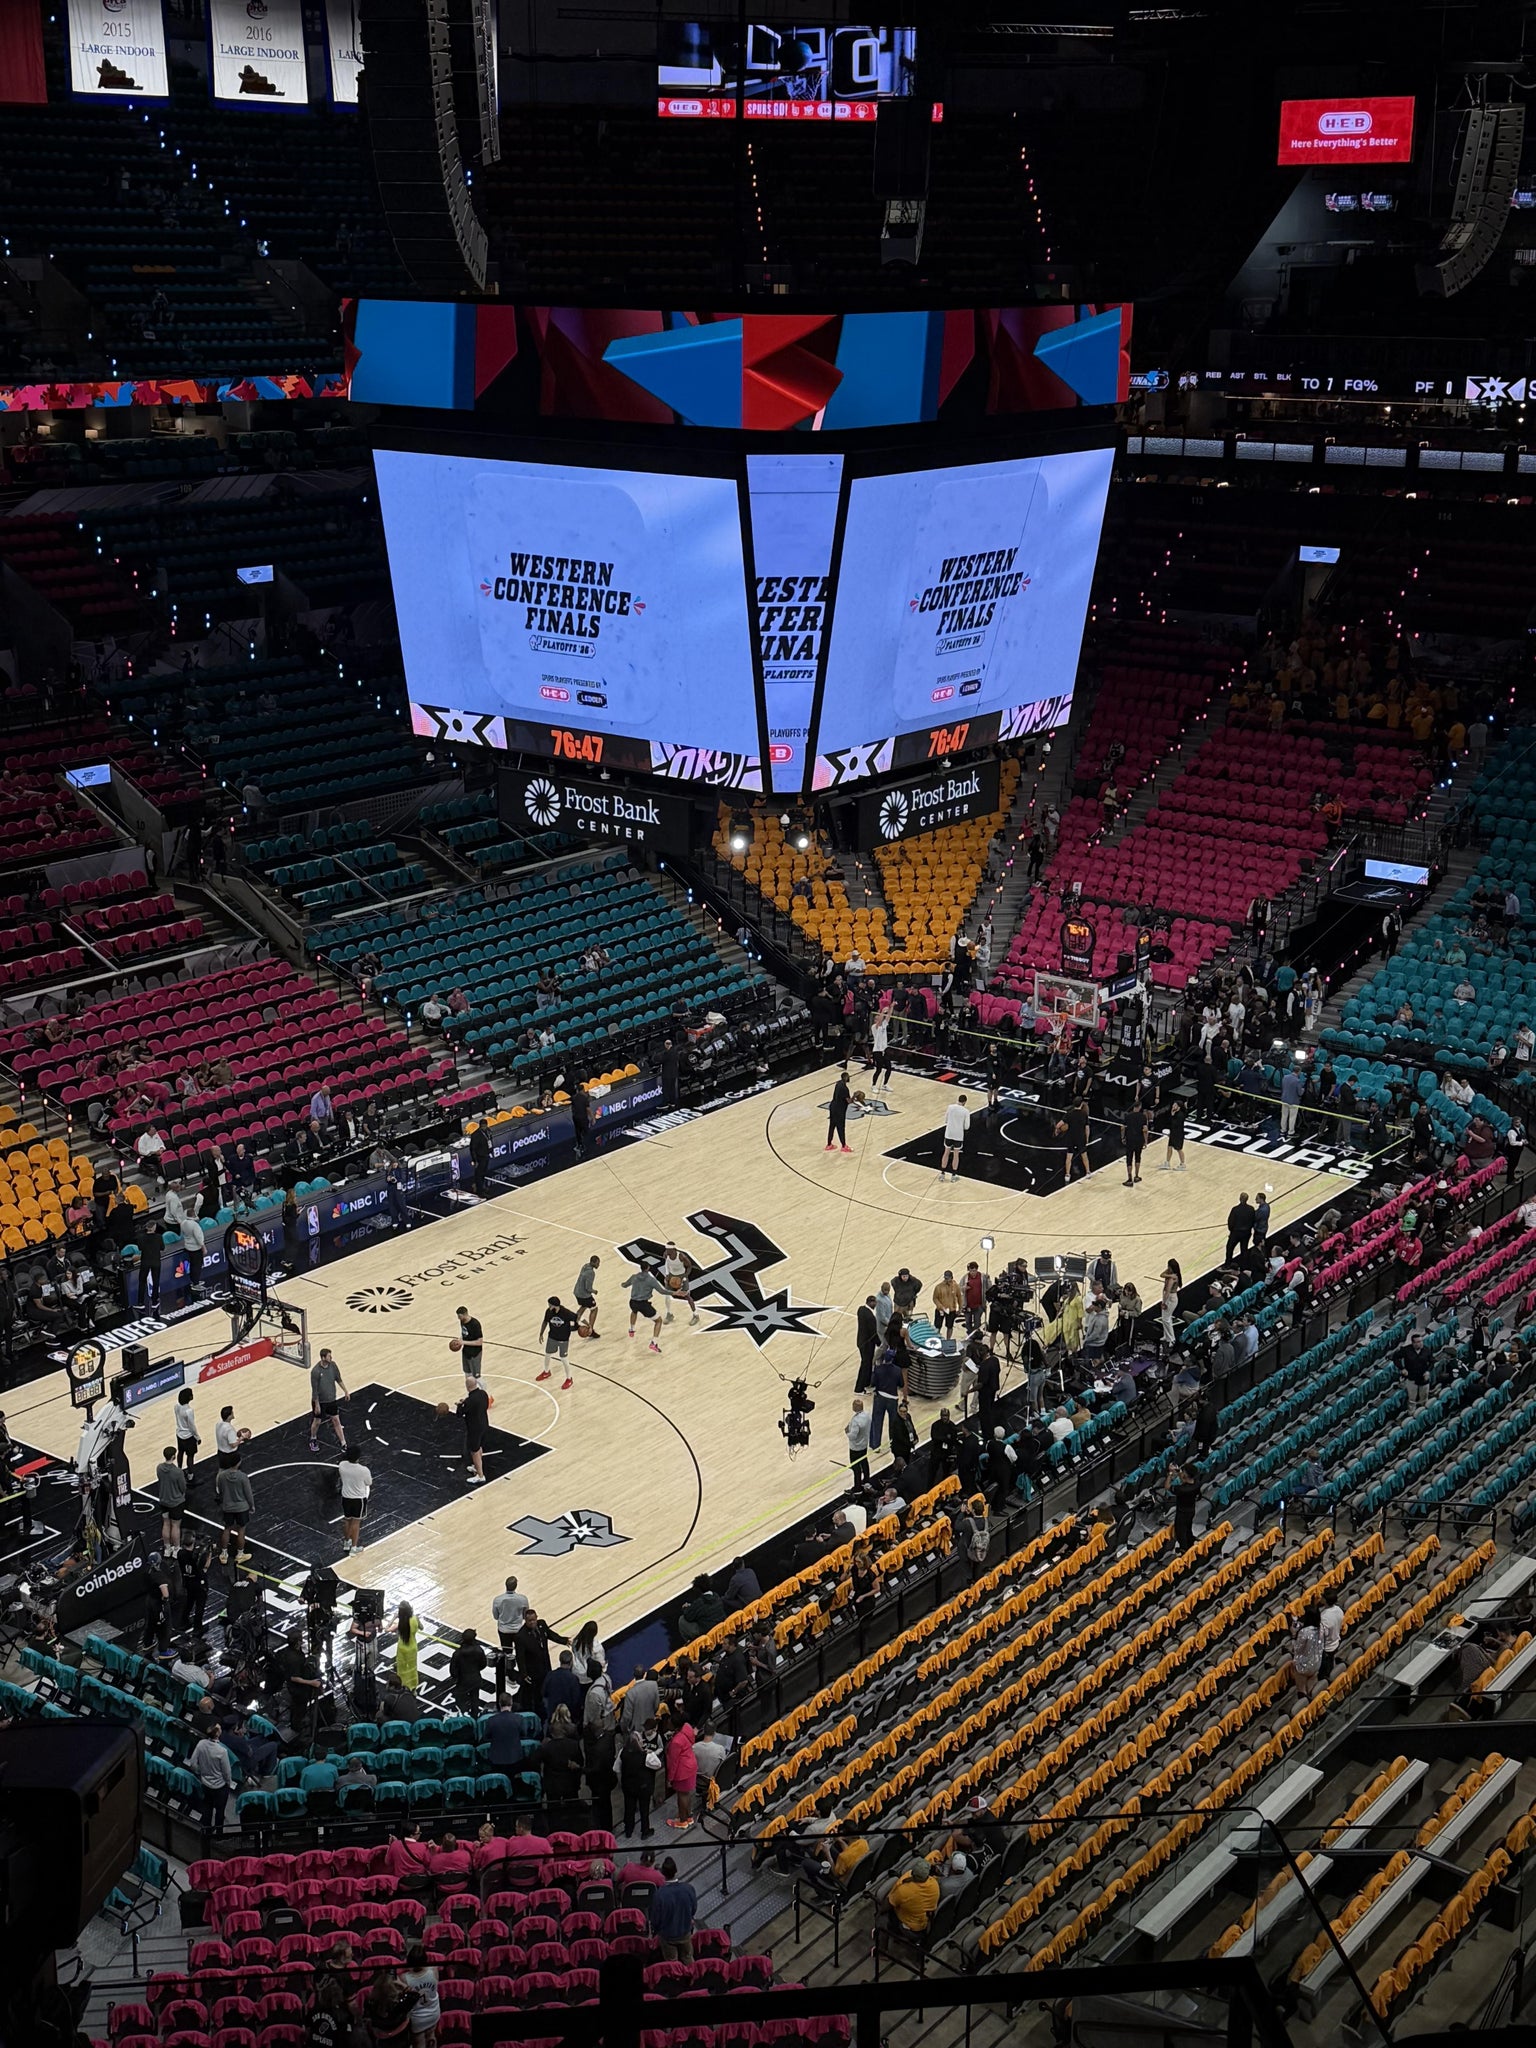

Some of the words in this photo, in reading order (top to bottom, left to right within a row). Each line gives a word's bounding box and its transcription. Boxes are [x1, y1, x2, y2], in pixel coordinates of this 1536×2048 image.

[102, 22, 132, 38] 2015
[246, 26, 273, 42] 2016
[81, 43, 113, 55] LARGE
[115, 44, 155, 57] INDOOR
[220, 43, 255, 57] LARGE
[257, 47, 300, 60] INDOOR
[1290, 139, 1312, 148] Here
[1313, 138, 1367, 149] Everything's
[1369, 137, 1398, 147] Better
[1205, 371, 1222, 379] REB
[1276, 373, 1292, 381] BLK
[1301, 378, 1319, 390] TO
[1344, 379, 1378, 391] FG%
[1415, 381, 1434, 393] PF
[510, 552, 614, 587] WESTERN
[938, 547, 1018, 583] WESTERN
[493, 577, 632, 616] CONFERENCE
[918, 572, 1024, 613] CONFERENCE
[525, 607, 600, 638] FINALS
[936, 602, 996, 636] FINALS
[764, 669, 814, 679] PLAYOFFS
[551, 729, 604, 763] 76:47
[770, 728, 801, 738] PLAYOFFS
[928, 723, 970, 758] 76:47
[564, 786, 610, 816] Frost
[613, 795, 661, 825] Bank
[911, 785, 945, 812] Frost
[946, 769, 980, 802] Bank
[577, 818, 645, 840] CENTER
[920, 803, 969, 827] CENTER
[609, 1099, 628, 1115] NBC
[633, 1085, 663, 1107] peacock
[635, 1108, 704, 1135] PLAYOFFS
[725, 1079, 777, 1099] Google
[512, 1128, 547, 1152] peacock
[350, 1195, 372, 1212] NBC
[393, 1258, 468, 1288] Frost
[456, 1234, 530, 1262] Bank
[440, 1249, 528, 1288] CENTER
[75, 1556, 143, 1598] coinbase
